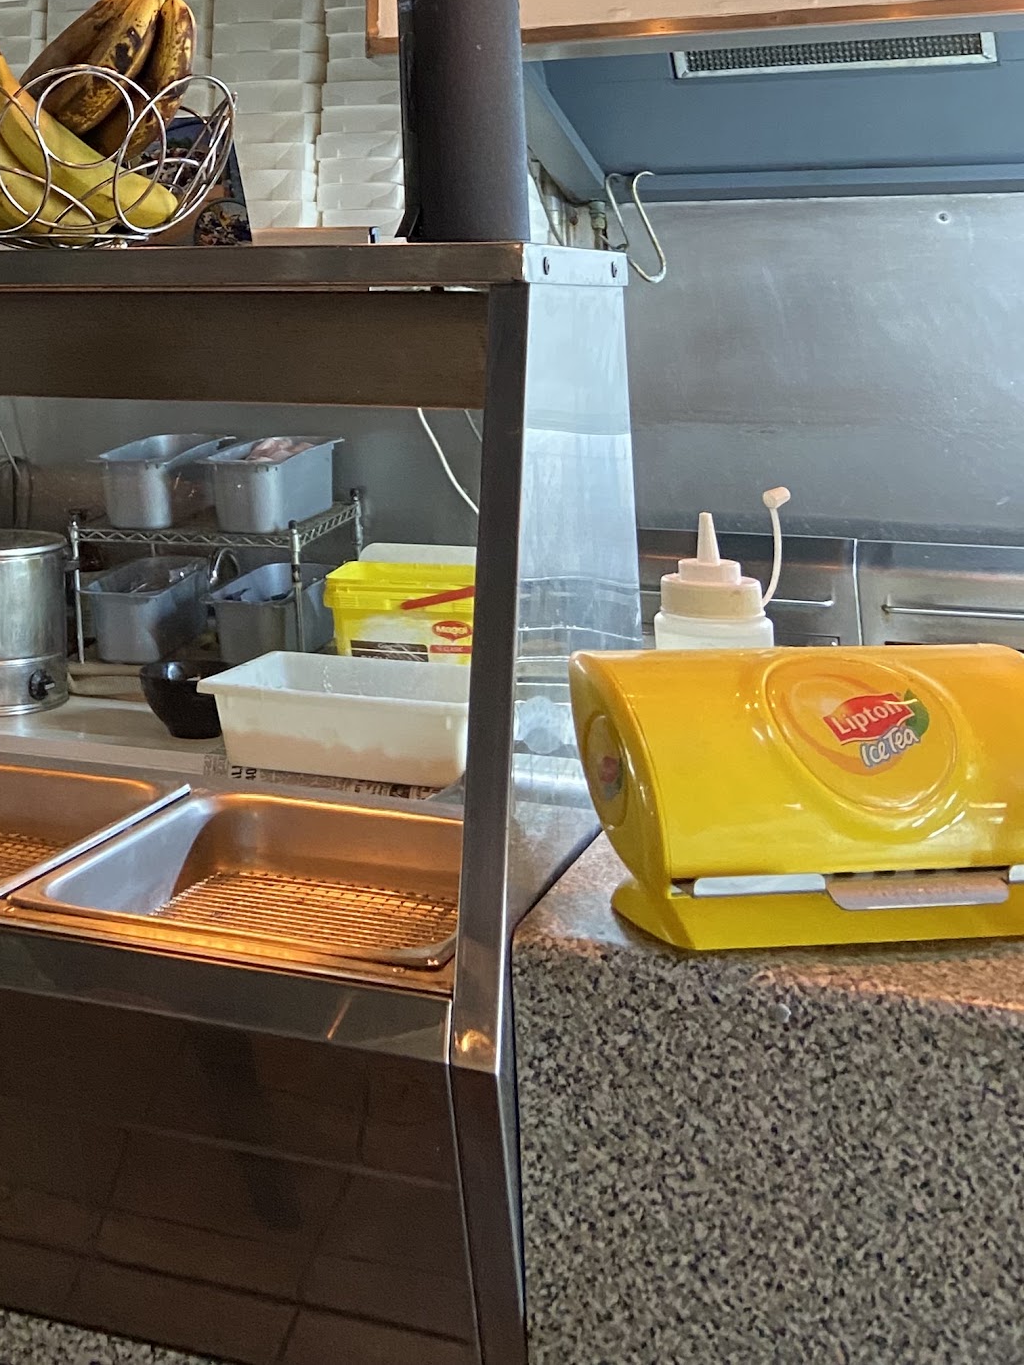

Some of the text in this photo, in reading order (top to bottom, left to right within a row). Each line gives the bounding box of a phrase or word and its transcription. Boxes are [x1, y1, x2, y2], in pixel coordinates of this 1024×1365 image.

[830, 701, 903, 735] Lipton
[861, 727, 920, 766] Ice Tea
